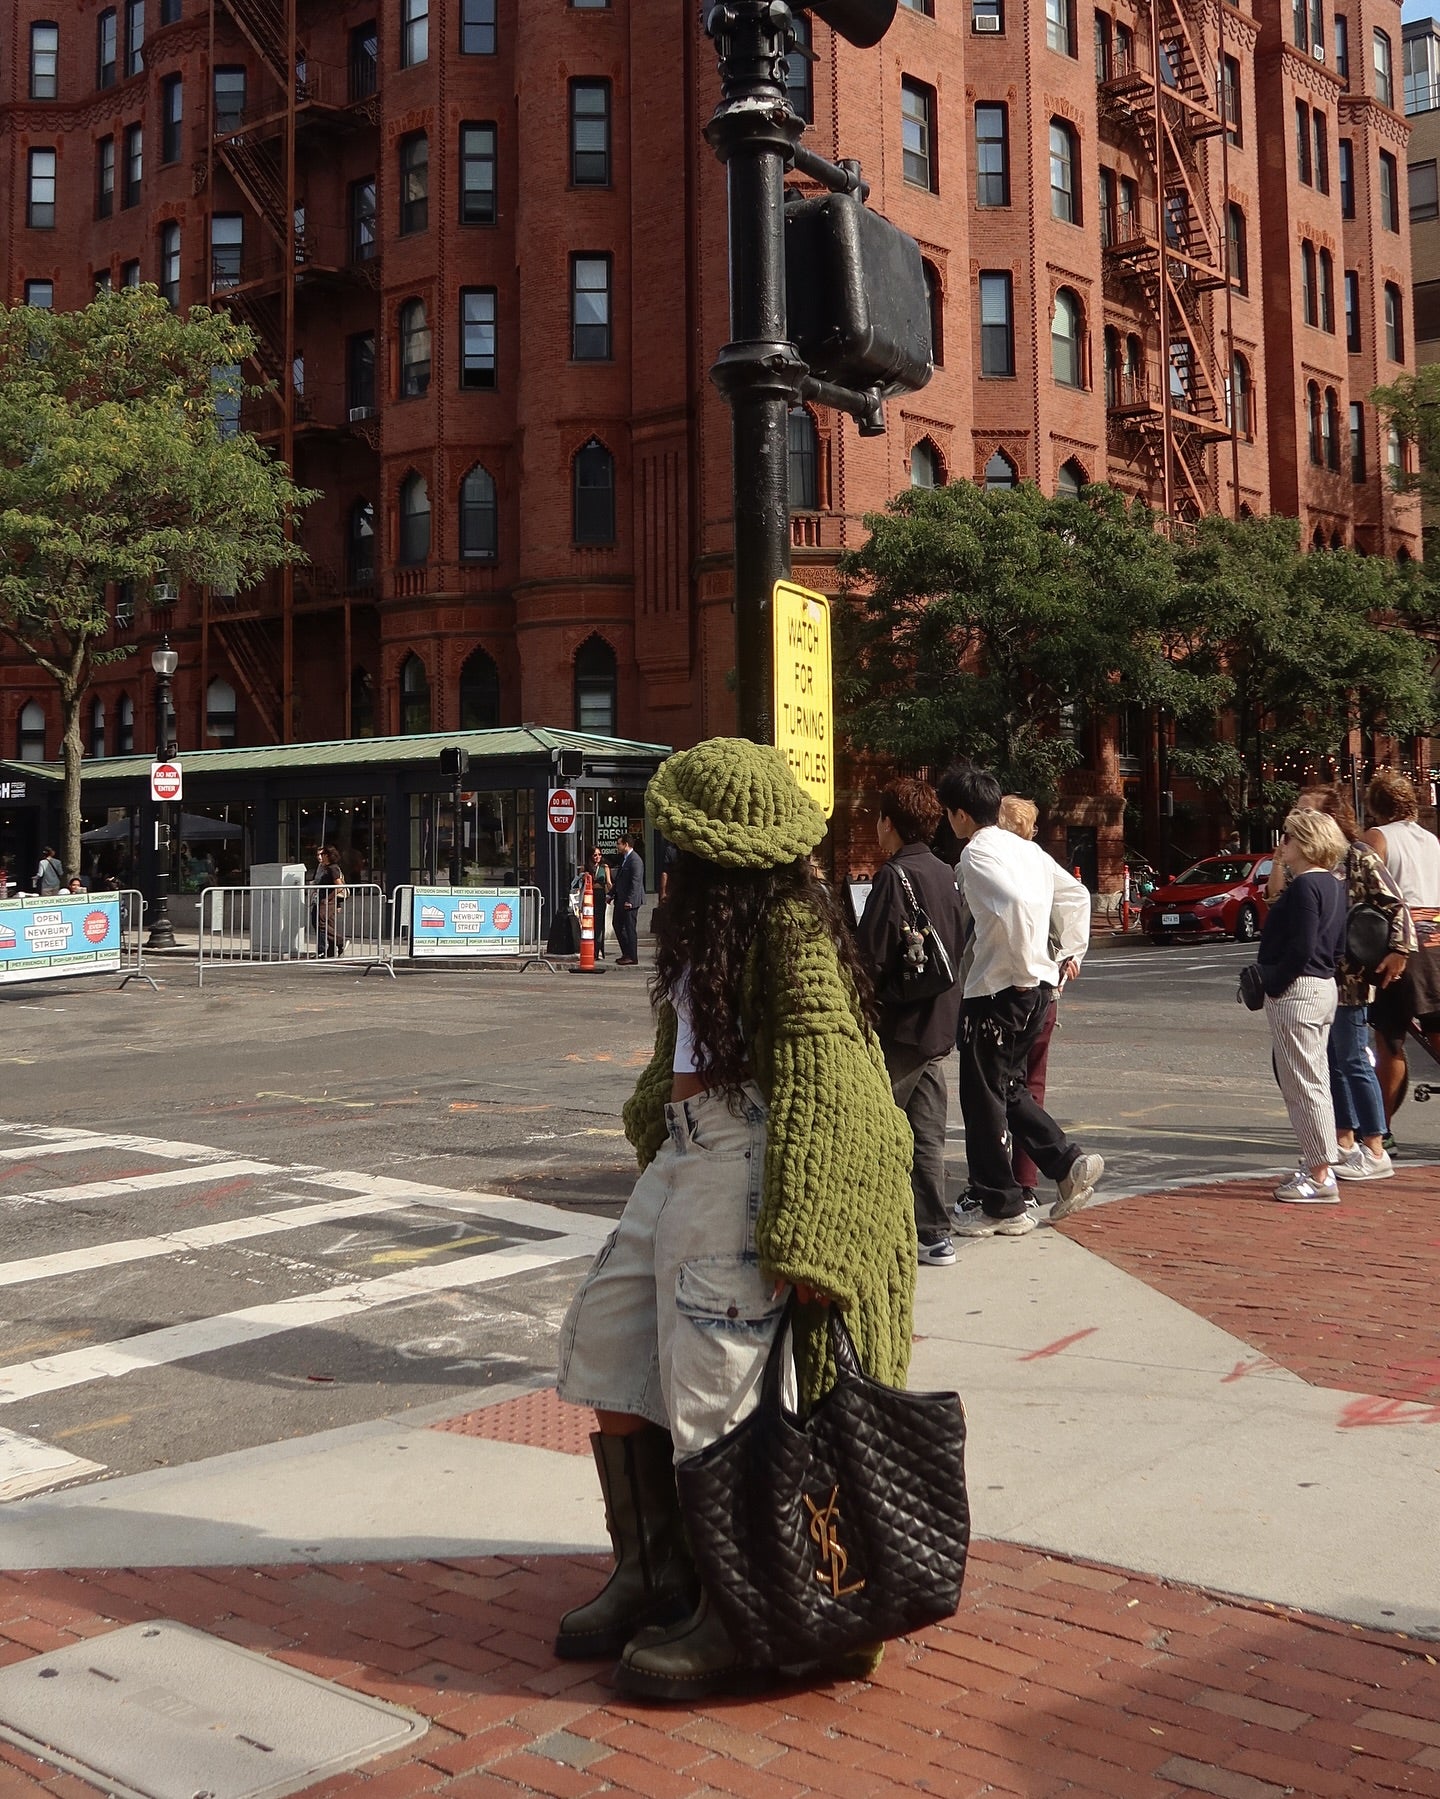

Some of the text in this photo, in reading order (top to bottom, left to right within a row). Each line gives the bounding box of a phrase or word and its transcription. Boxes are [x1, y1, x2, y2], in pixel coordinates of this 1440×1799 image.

[788, 616, 819, 655] WATCH
[795, 662, 813, 696] FOR
[784, 703, 824, 741] TURNING
[786, 747, 827, 785] EHICLES
[552, 798, 571, 806] DO NOT
[553, 816, 569, 824] ENTER
[597, 816, 628, 828] LUSH
[597, 840, 618, 848] HANDM
[36, 914, 60, 923] OPEN
[27, 925, 70, 937] NEWBURY
[34, 939, 65, 949] STREET
[802, 1484, 866, 1599] YSL
